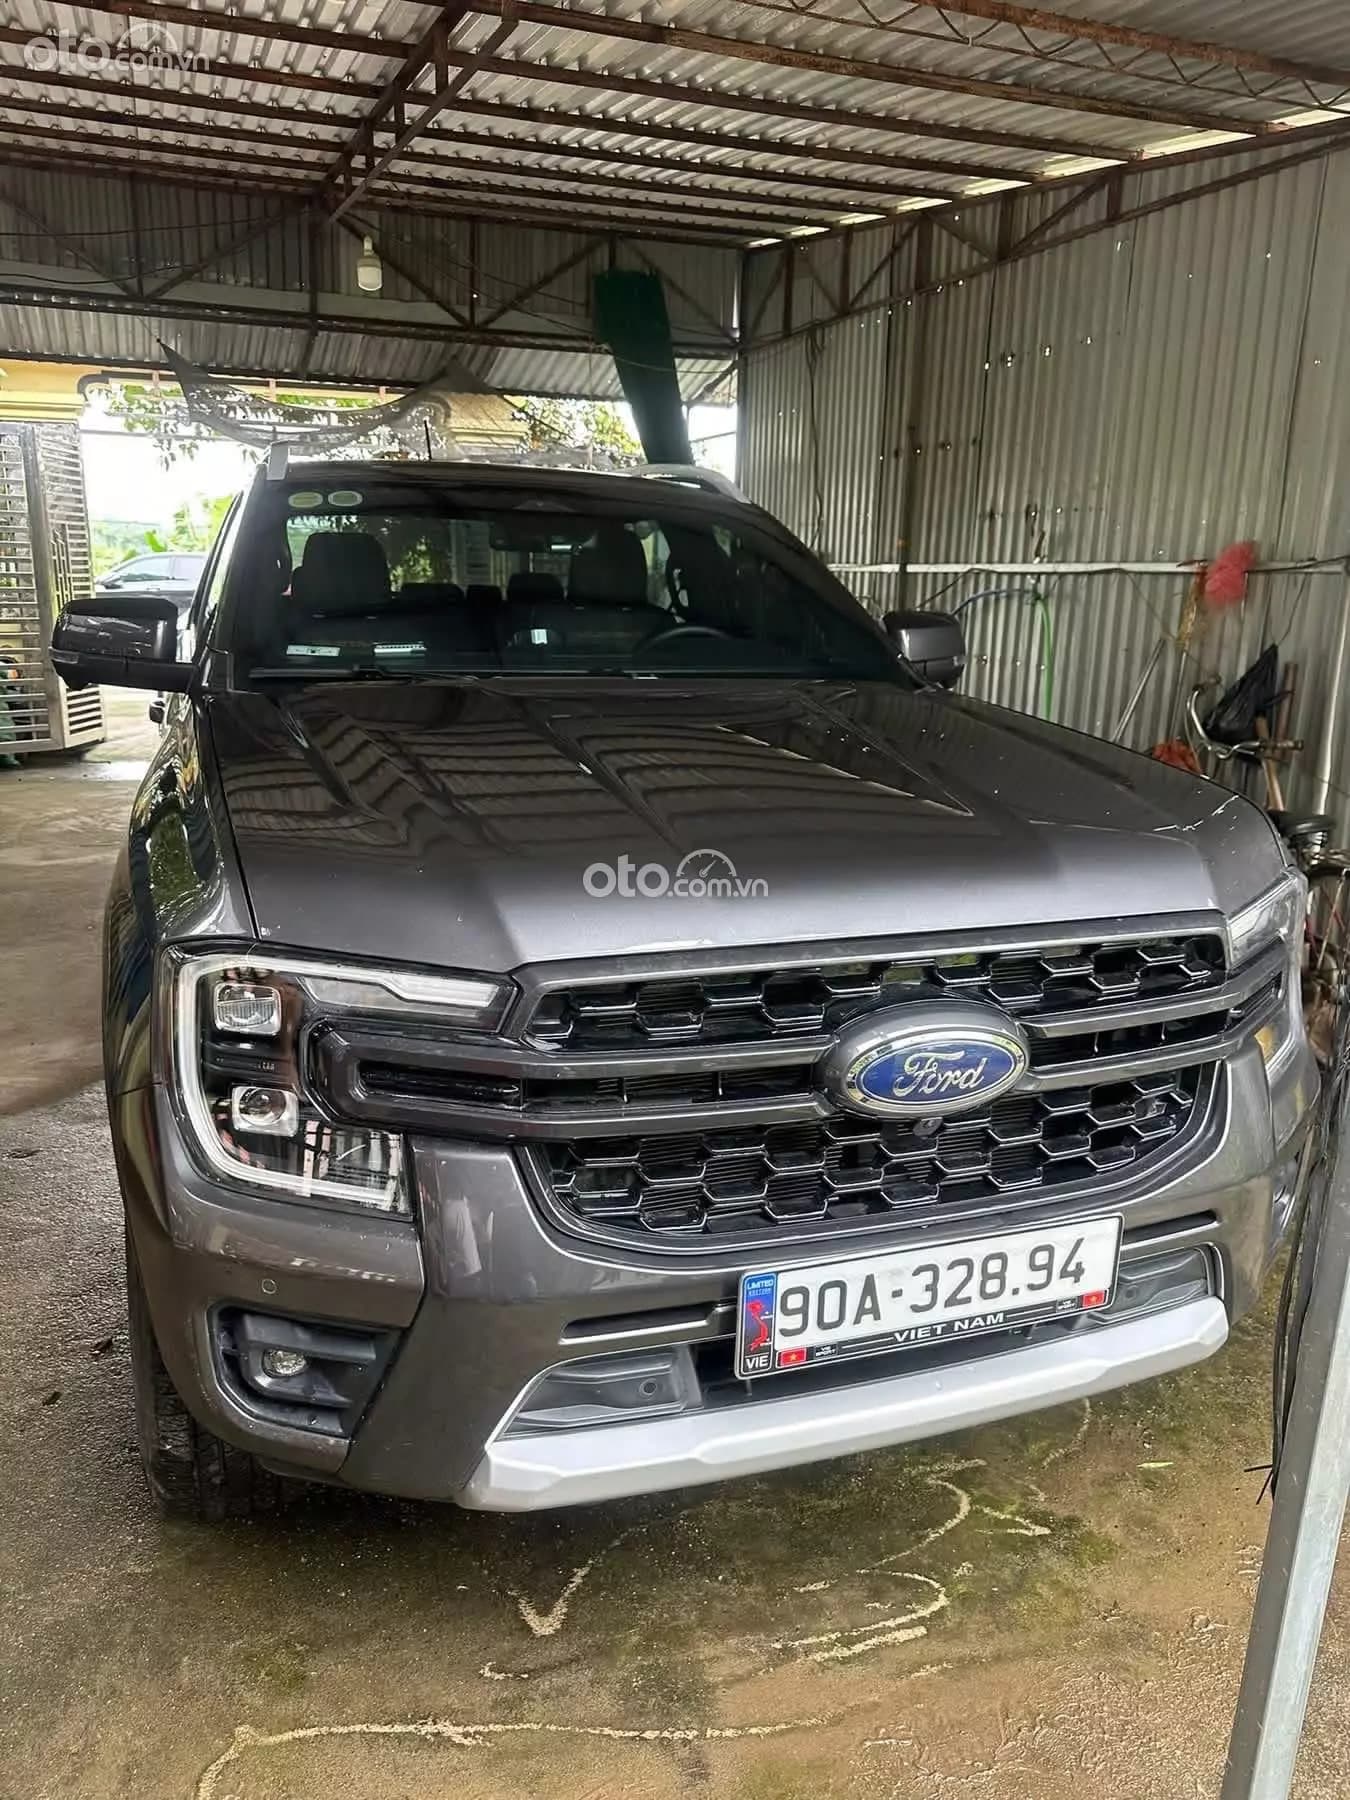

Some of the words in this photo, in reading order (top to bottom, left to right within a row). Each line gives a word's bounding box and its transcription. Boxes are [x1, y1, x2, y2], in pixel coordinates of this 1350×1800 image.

[893, 1050, 988, 1097] Ford
[779, 1237, 1085, 1337] 90A-328.94
[894, 1323, 947, 1343] VIET
[953, 1311, 1005, 1332] NAM
[746, 1355, 769, 1369] VIE
